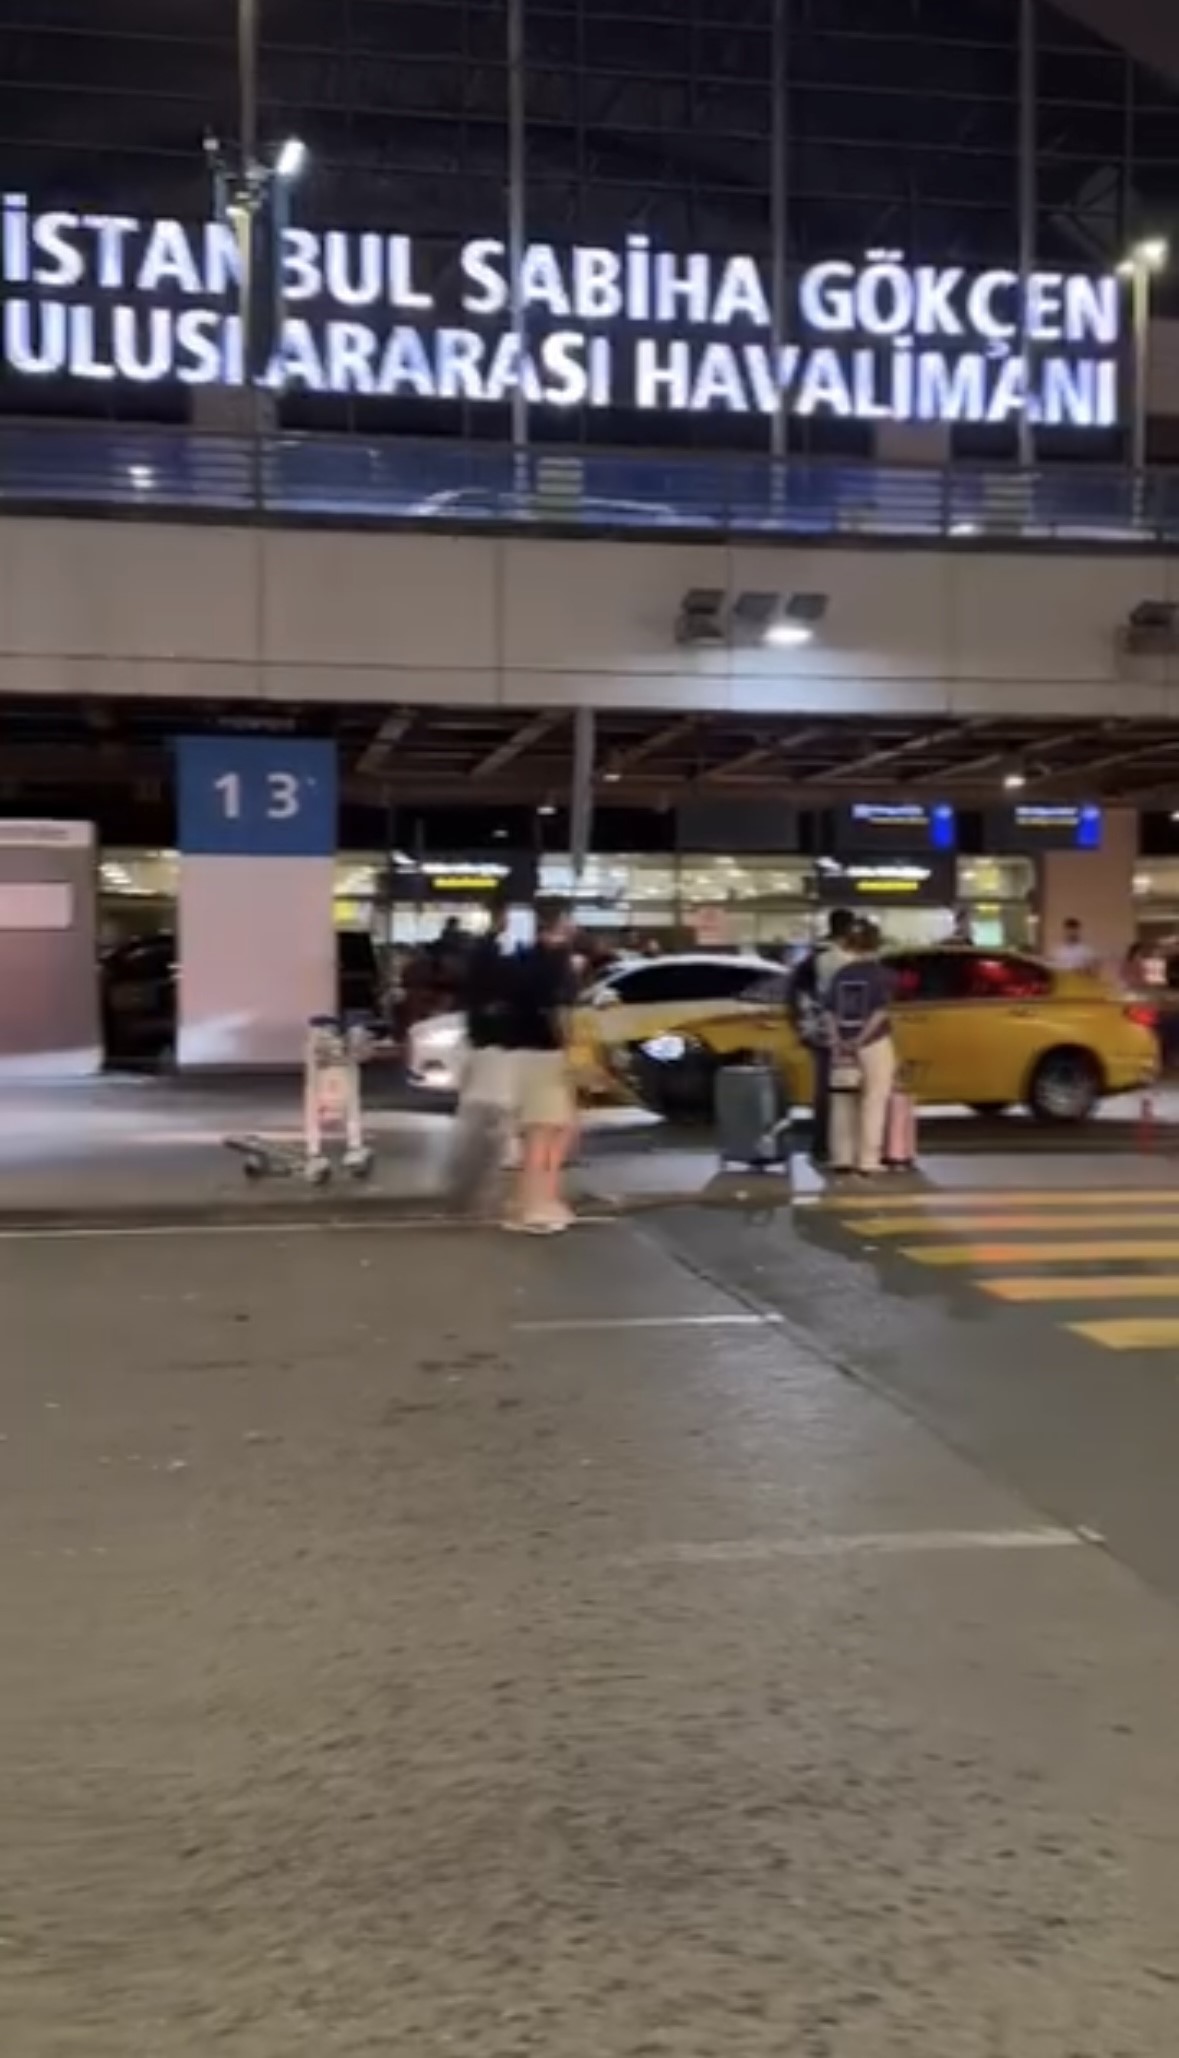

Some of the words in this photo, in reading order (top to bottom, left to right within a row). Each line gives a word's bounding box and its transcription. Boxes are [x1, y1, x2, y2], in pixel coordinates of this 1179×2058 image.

[3, 193, 433, 308] İSTANBUL
[459, 234, 771, 327] SABİHA
[800, 248, 1118, 358] GÖKÇEN
[635, 336, 1117, 426] HAVALİMANI
